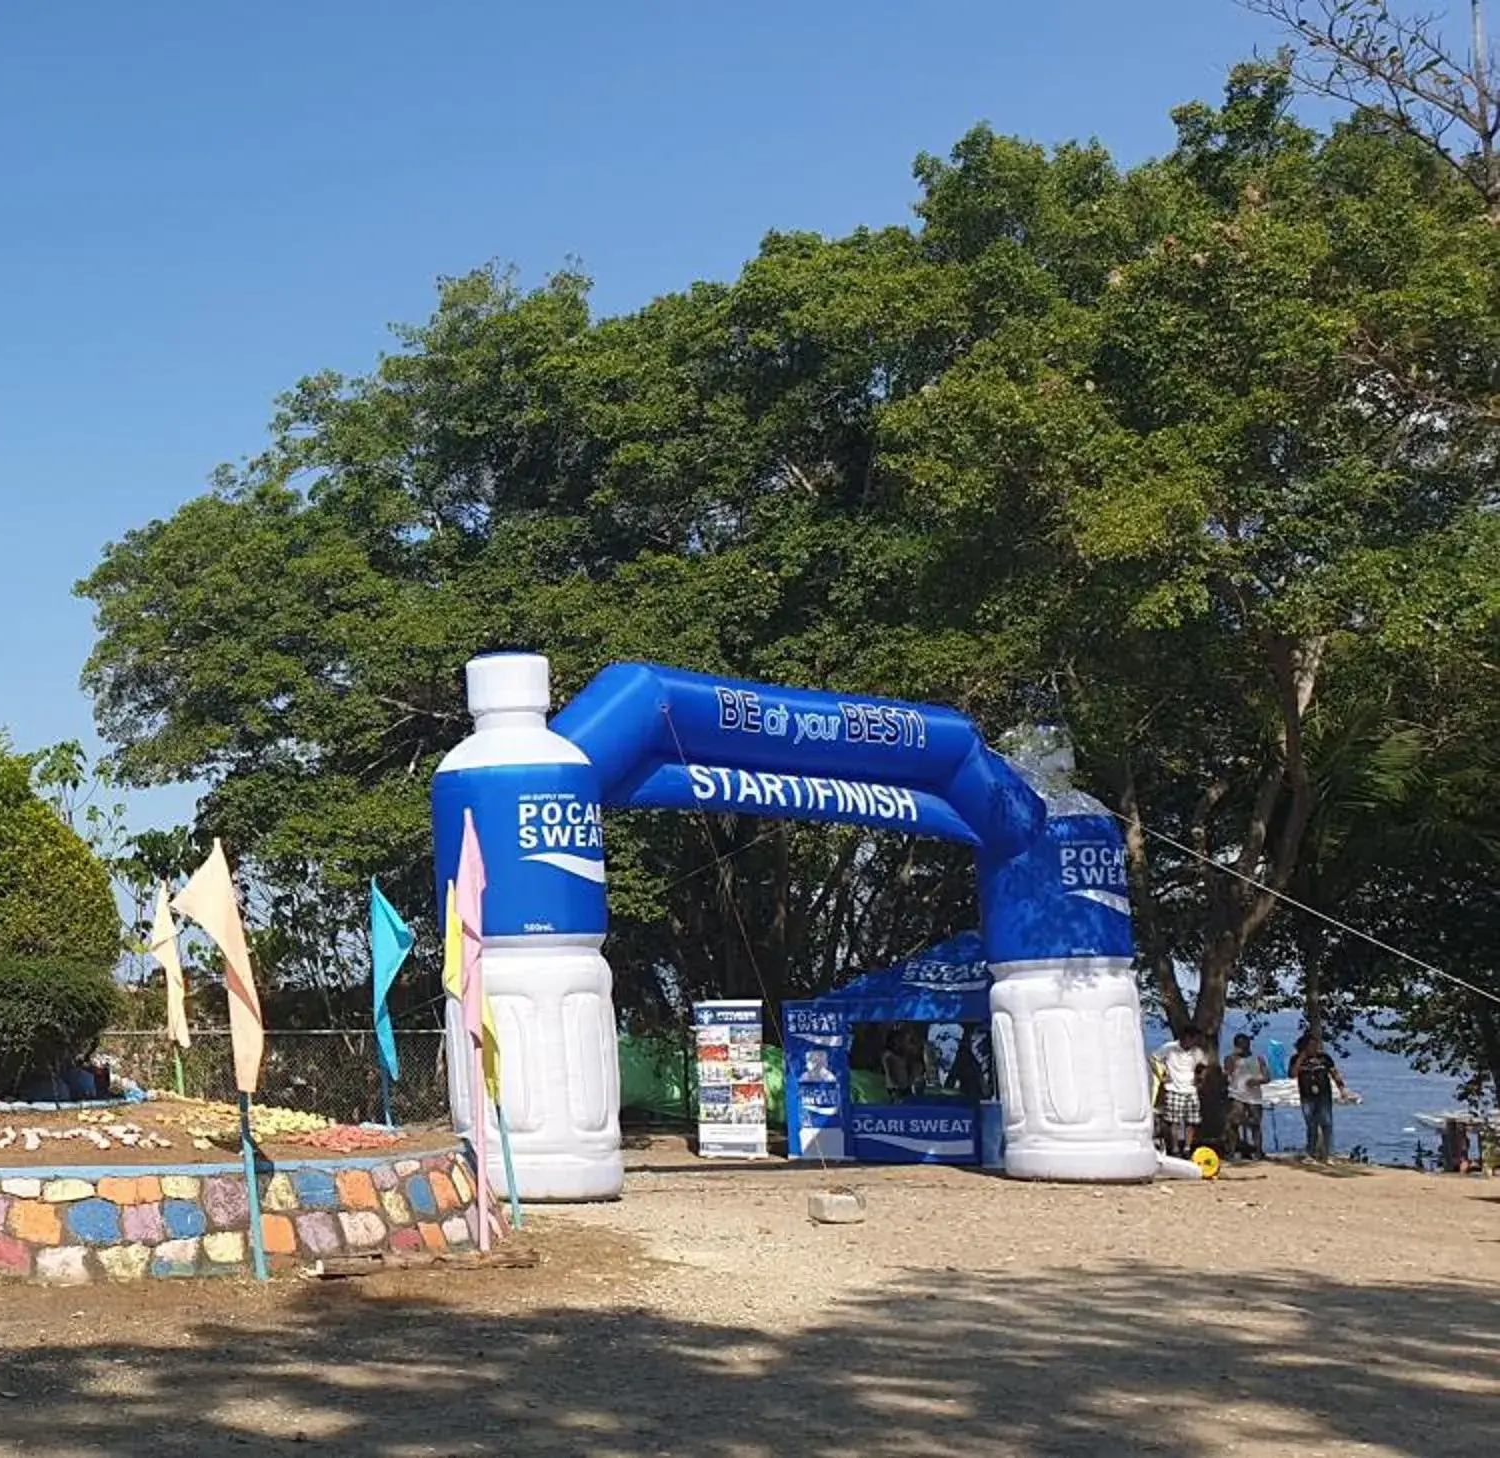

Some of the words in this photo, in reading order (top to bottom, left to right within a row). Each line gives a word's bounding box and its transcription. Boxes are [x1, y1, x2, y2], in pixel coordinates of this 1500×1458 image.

[715, 686, 763, 733] BE
[764, 704, 790, 737] at
[794, 712, 841, 745] your
[838, 701, 927, 749] BEST!
[687, 763, 918, 822] START/FINISH
[909, 1119, 973, 1133] SWEAT
